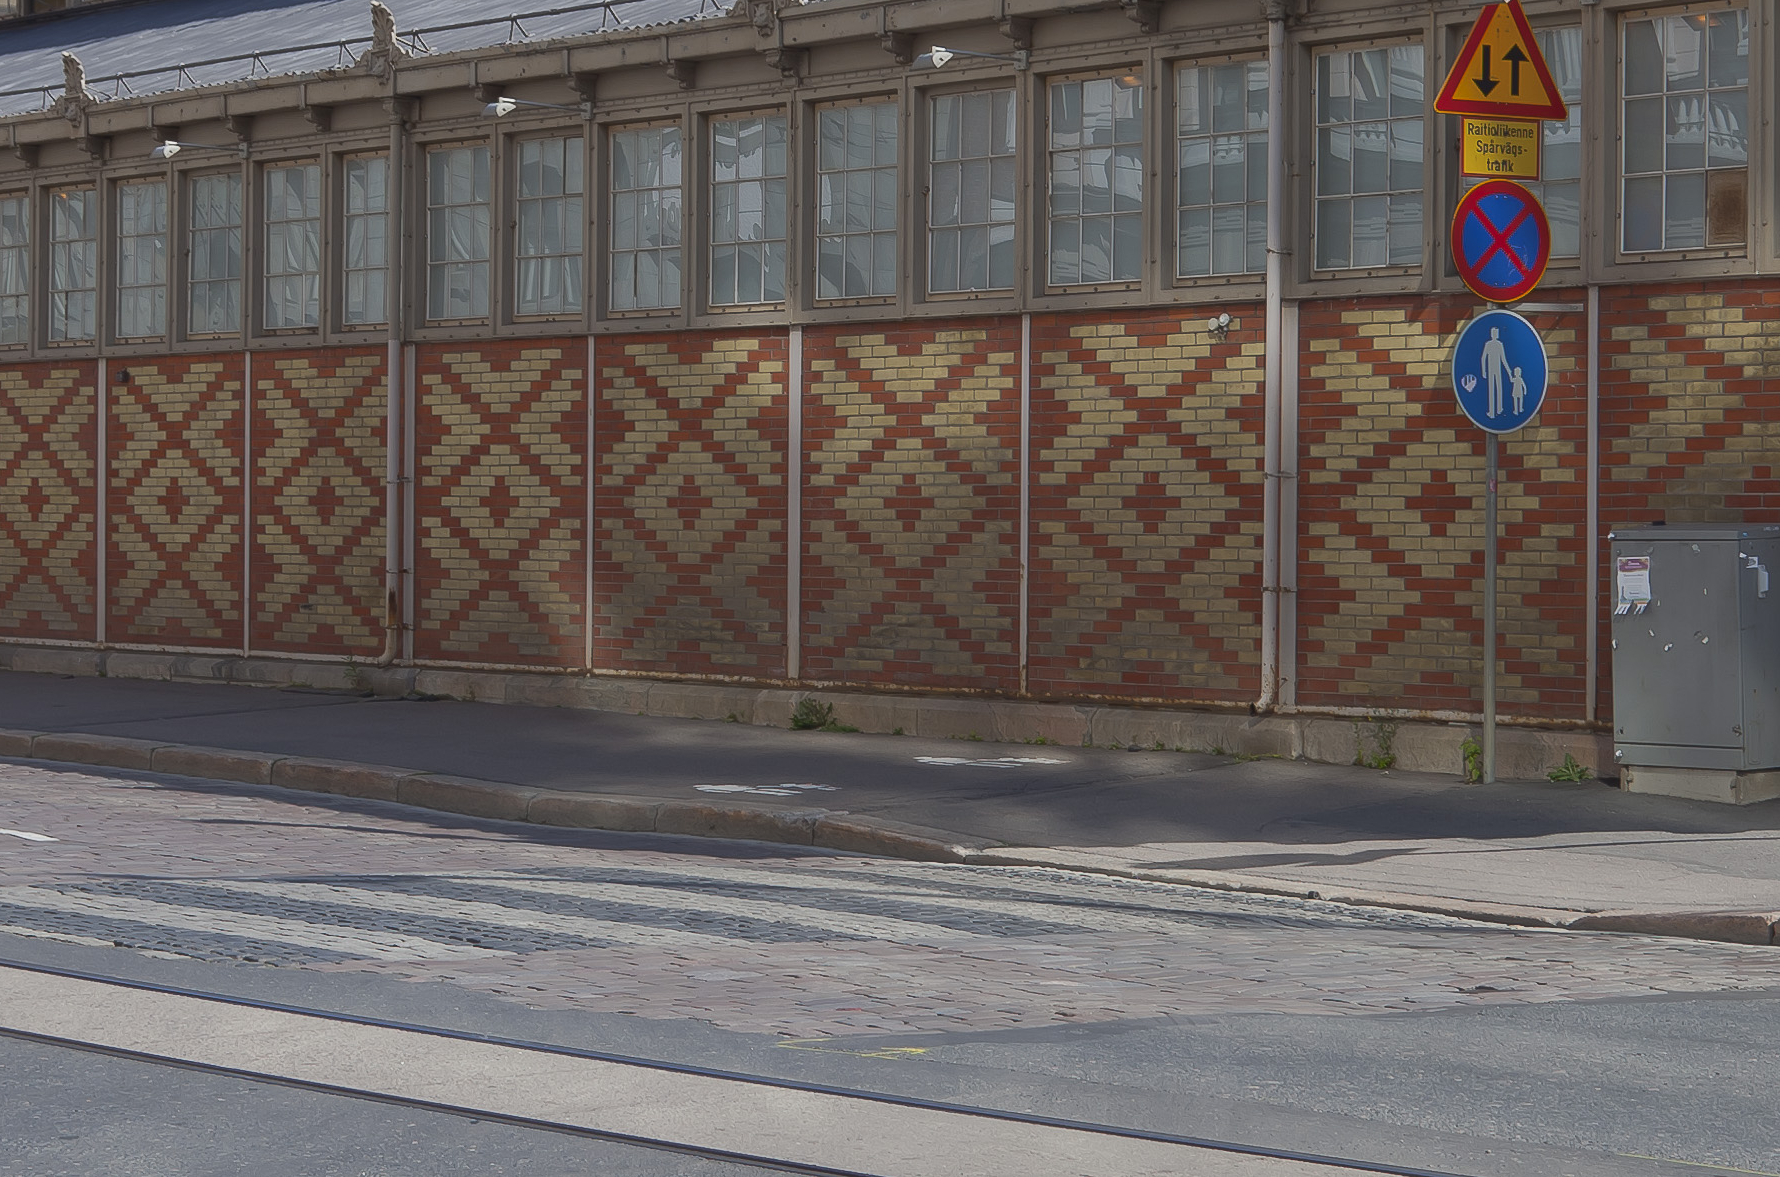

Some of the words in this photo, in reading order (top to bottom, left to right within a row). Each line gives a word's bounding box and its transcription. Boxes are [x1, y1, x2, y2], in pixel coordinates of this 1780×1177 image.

[1467, 122, 1534, 139] Raitioliikenne
[1476, 139, 1528, 157] Spårvägs-
[1486, 157, 1514, 172] trafik
